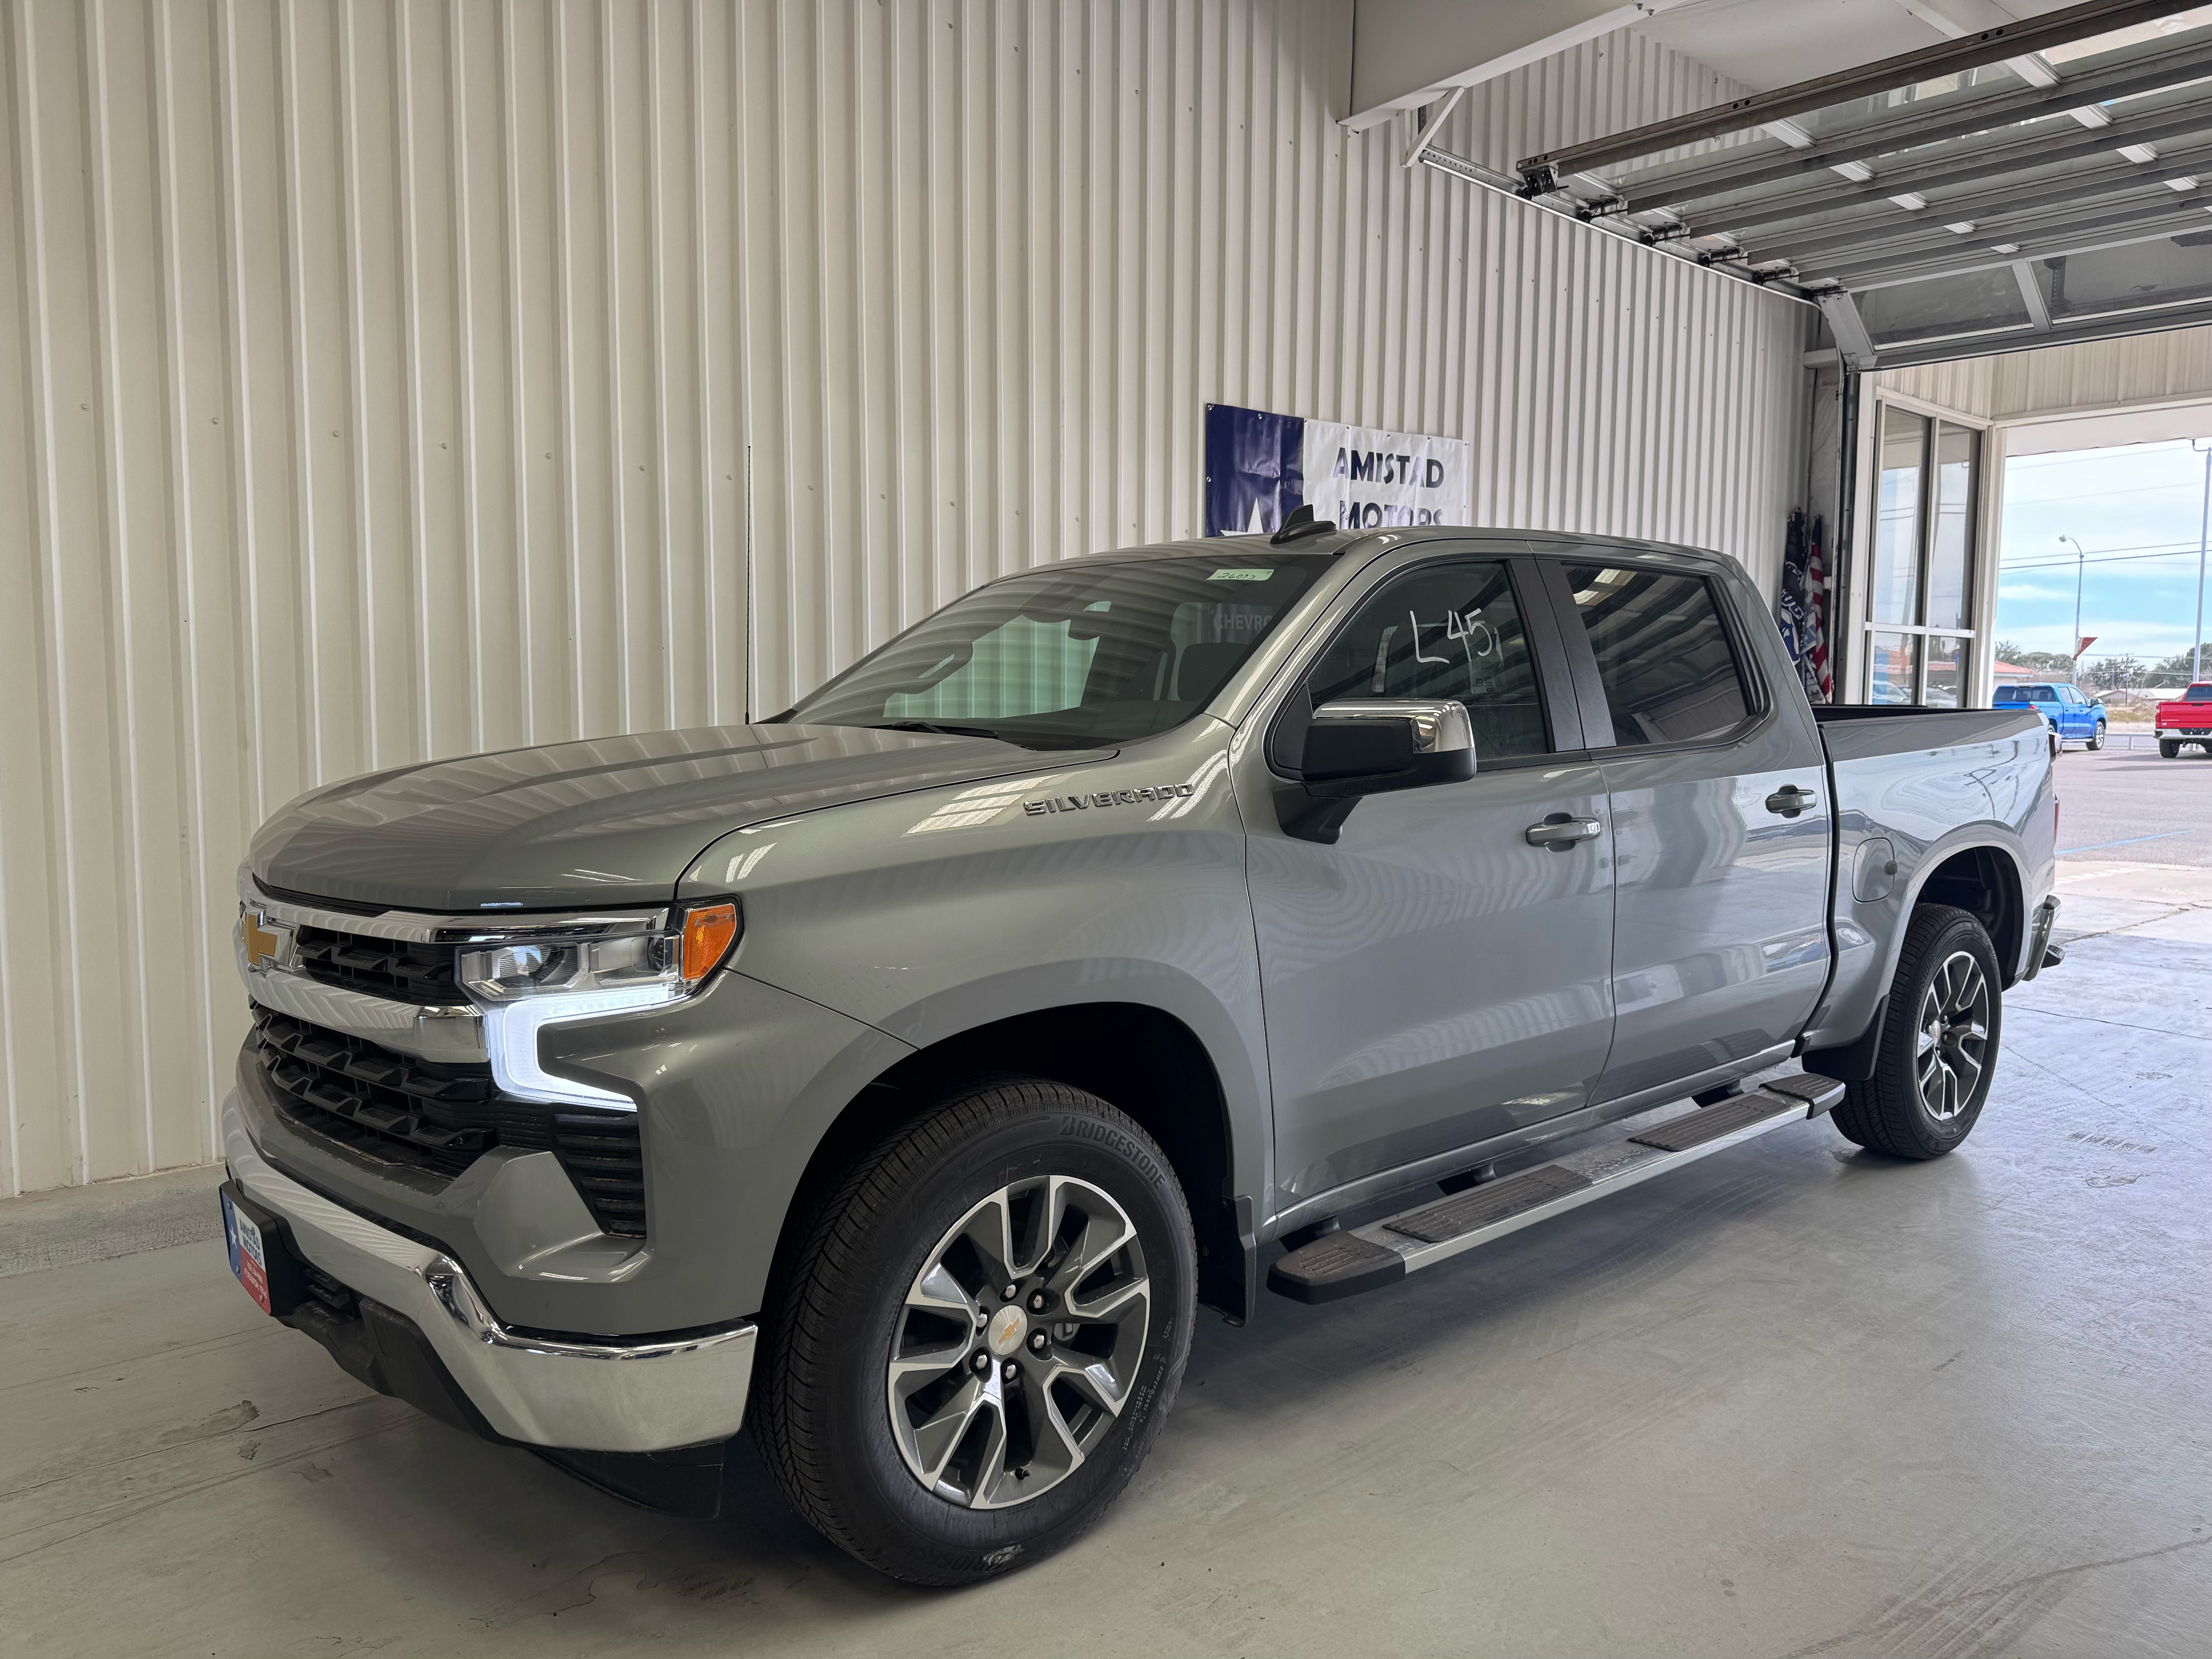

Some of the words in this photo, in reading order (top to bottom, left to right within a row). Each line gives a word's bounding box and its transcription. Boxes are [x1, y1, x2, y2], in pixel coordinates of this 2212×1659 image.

[1333, 447, 1444, 488] AMISTAD
[1023, 783, 1194, 816] SILVERADO
[1058, 1116, 1166, 1189] BRIDGESTONE
[242, 1235, 262, 1266] MOTORS
